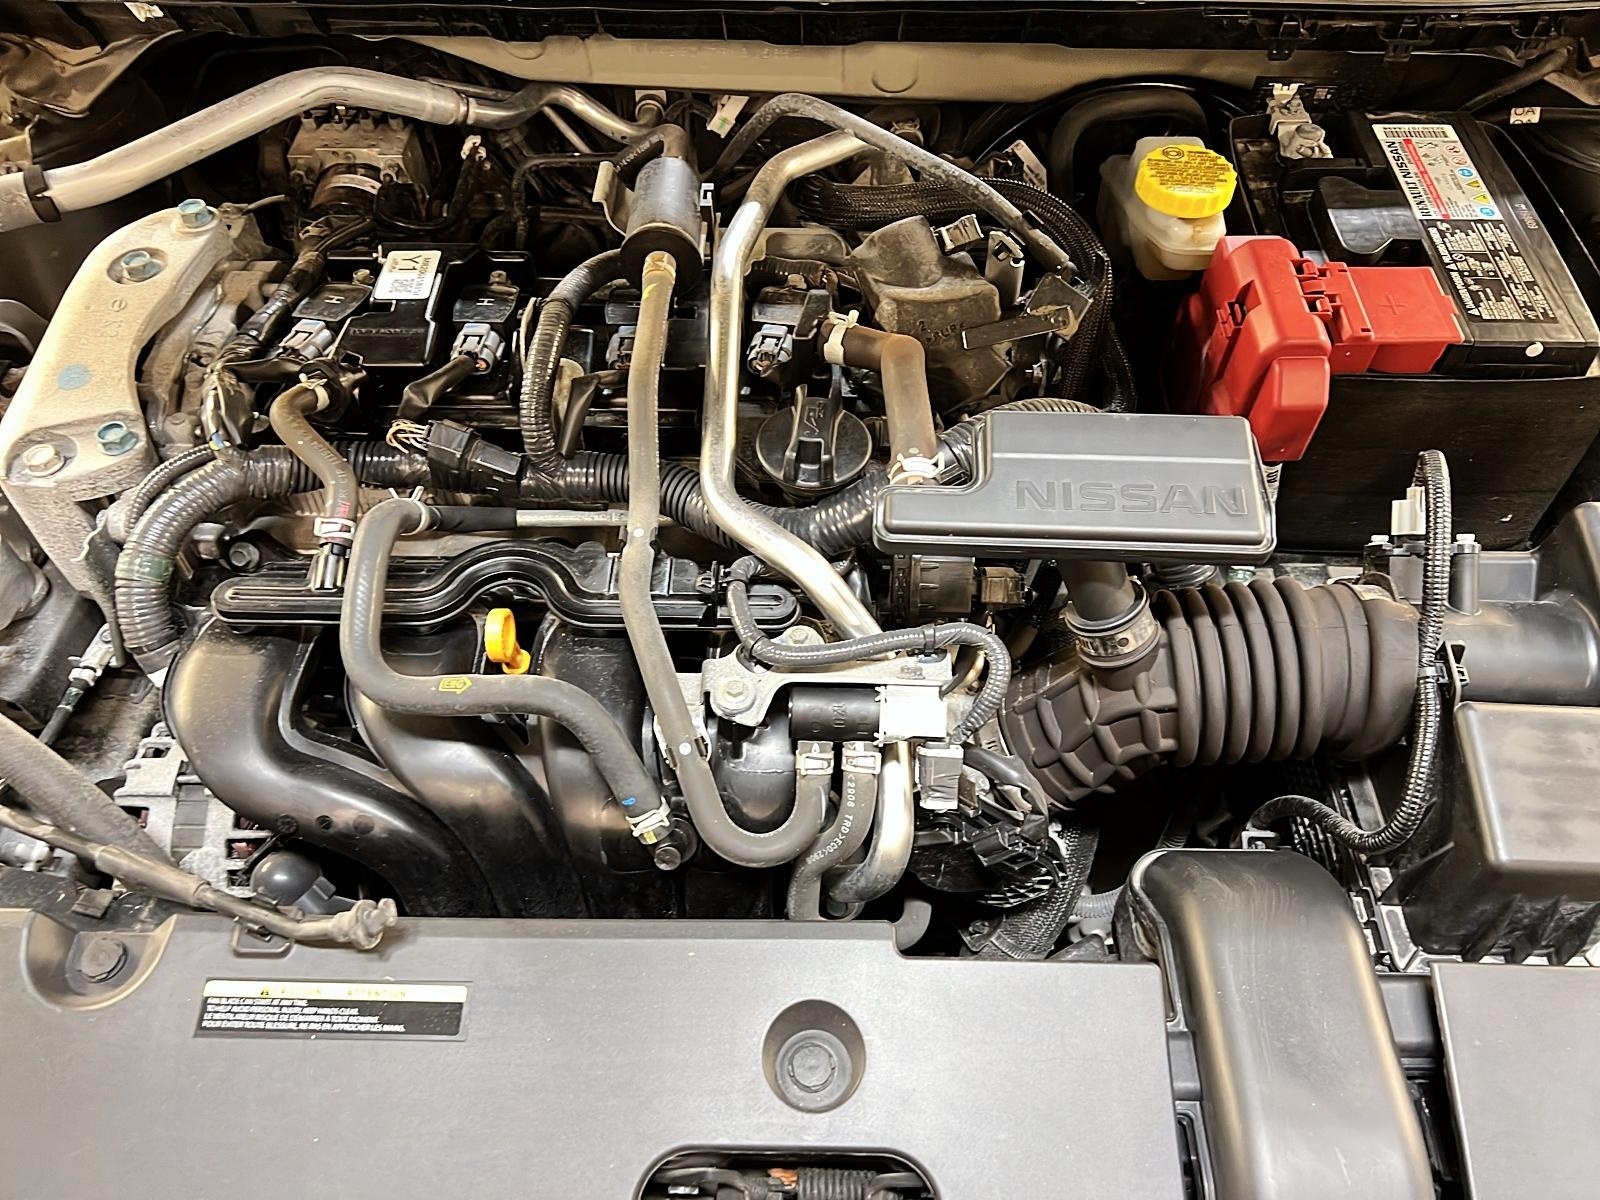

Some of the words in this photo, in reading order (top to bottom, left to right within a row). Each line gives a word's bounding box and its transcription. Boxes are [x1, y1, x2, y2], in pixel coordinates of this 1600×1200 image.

[1385, 140, 1413, 179] NISSAN
[1404, 180, 1432, 217] RENAULT
[397, 254, 423, 271] Y1
[1015, 479, 1249, 516] NISSAN
